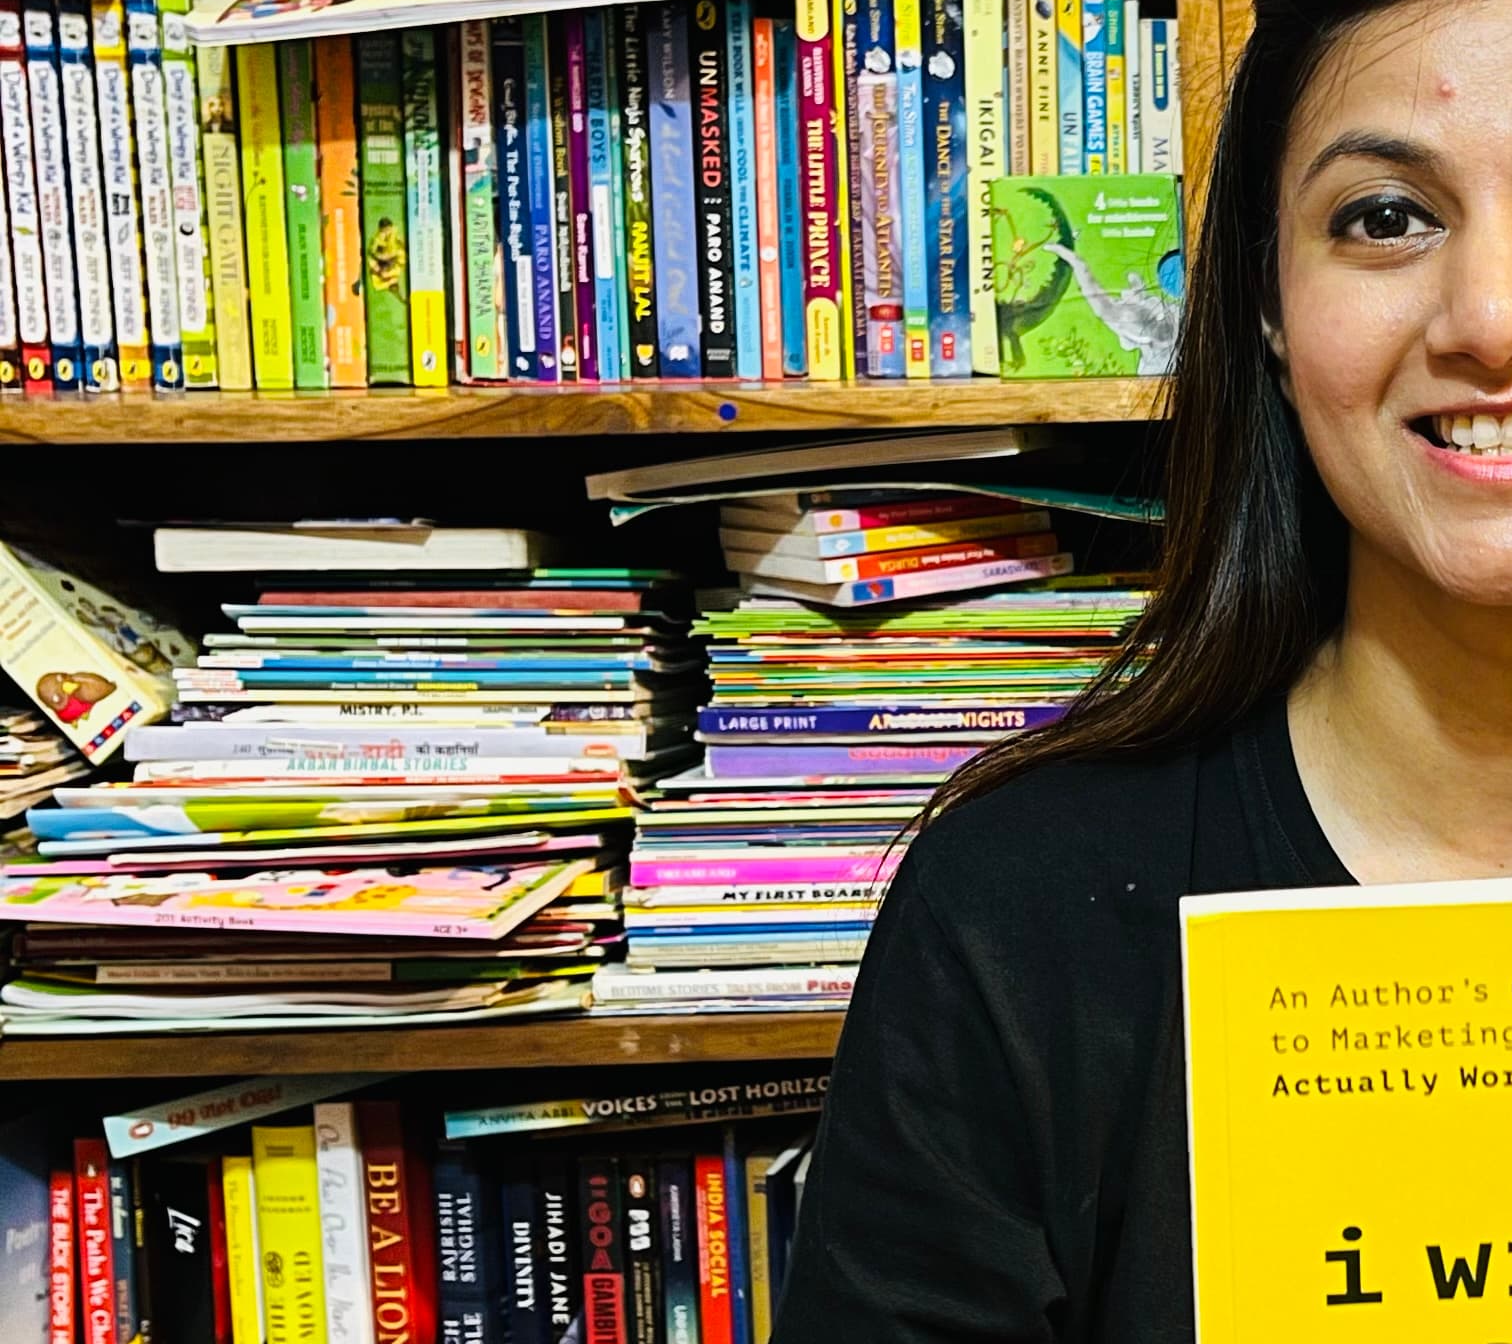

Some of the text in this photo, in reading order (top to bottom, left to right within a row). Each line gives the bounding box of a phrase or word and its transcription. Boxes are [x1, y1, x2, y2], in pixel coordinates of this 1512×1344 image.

[698, 52, 724, 333] UNMASKED PARO ANAND
[403, 704, 424, 716] P.I.
[718, 715, 817, 731] LARGE PRINT
[1269, 984, 1309, 1011] An
[1330, 978, 1490, 1009] Author's
[1271, 1028, 1310, 1054] to
[1272, 1068, 1438, 1099] Actually
[581, 1085, 740, 1118] VOICES LOST
[368, 1163, 400, 1215] BE
[706, 1173, 723, 1224] INDIA
[371, 1225, 403, 1250] A
[708, 1228, 728, 1297] SOCIAL
[1325, 1225, 1383, 1307] i
